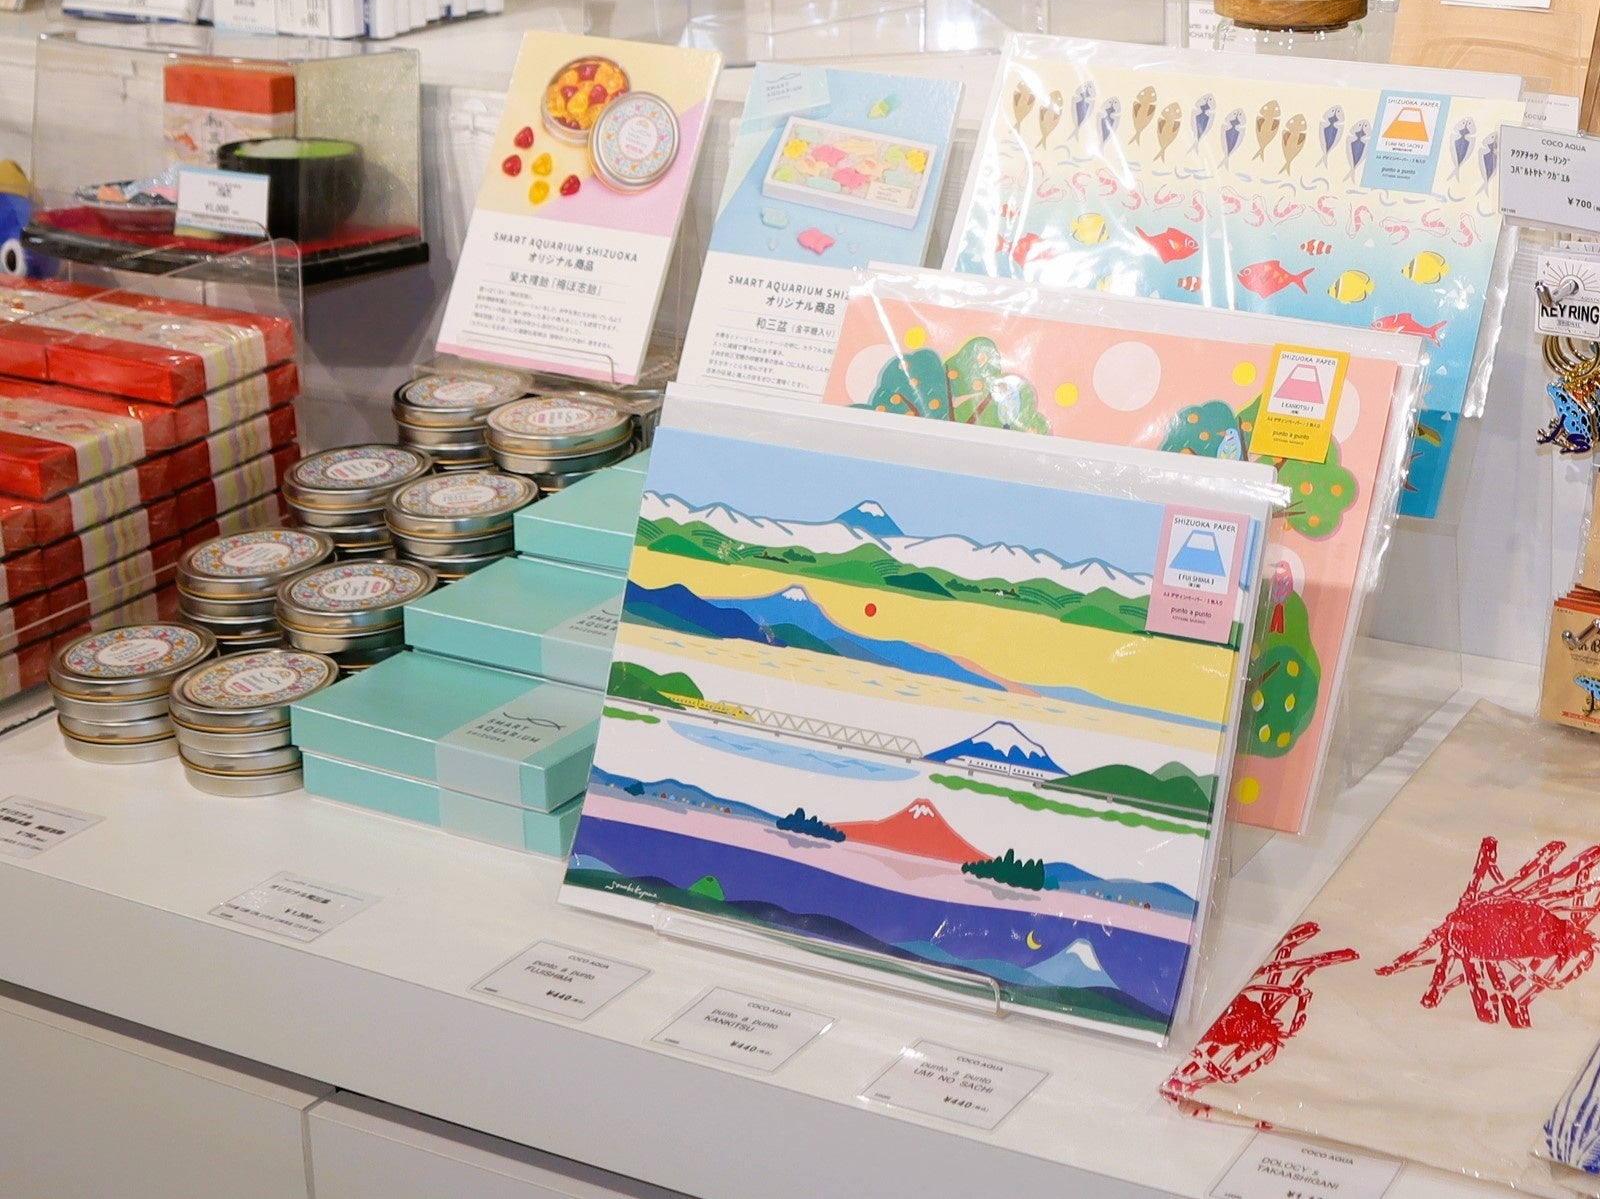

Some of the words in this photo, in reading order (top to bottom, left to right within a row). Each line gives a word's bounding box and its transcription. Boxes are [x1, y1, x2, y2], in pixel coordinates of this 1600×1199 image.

[1387, 98, 1418, 106] SHIZUOKA
[1541, 138, 1564, 148] COCO
[1565, 143, 1587, 152] AQUA
[1567, 197, 1592, 209] ¥700
[492, 232, 527, 245] SMART
[528, 237, 584, 254] AQUARIUM
[585, 246, 638, 262] SHIZUOKA
[528, 252, 594, 272] オリジナル商品
[727, 275, 764, 288] SMART
[765, 280, 824, 297] AQUARIUM
[765, 295, 836, 316] オリジナル商品
[755, 317, 789, 333] 和三盆
[1280, 353, 1314, 363] SHIZUOKA
[1315, 358, 1336, 366] PAPER
[1174, 517, 1211, 529] SHIZUOKA
[1213, 522, 1237, 533] PAPER
[1170, 606, 1188, 615] punto
[1194, 609, 1212, 618] punto
[486, 718, 530, 732] SMART
[532, 960, 558, 970] punto
[569, 969, 596, 980] punto
[568, 954, 589, 964] COCO
[589, 960, 610, 970] AQUA
[524, 965, 574, 983] FUJISHIMA
[747, 1002, 771, 1012] COCO
[771, 1007, 792, 1018] AQUA
[704, 1014, 756, 1033] KANKITSU
[711, 1008, 739, 1019] punto
[751, 1018, 779, 1030] punto
[956, 1056, 981, 1067] COCO
[981, 1062, 1004, 1072] AQUA
[913, 1067, 935, 1079] UMI
[937, 1074, 955, 1085] NO
[959, 1080, 994, 1095] SACHI
[919, 1062, 949, 1073] punto
[963, 1073, 992, 1085] punto
[1301, 1148, 1328, 1159] COCO
[1328, 1154, 1354, 1165] AQUA
[1256, 1164, 1340, 1191] TAKAASHIGANI
